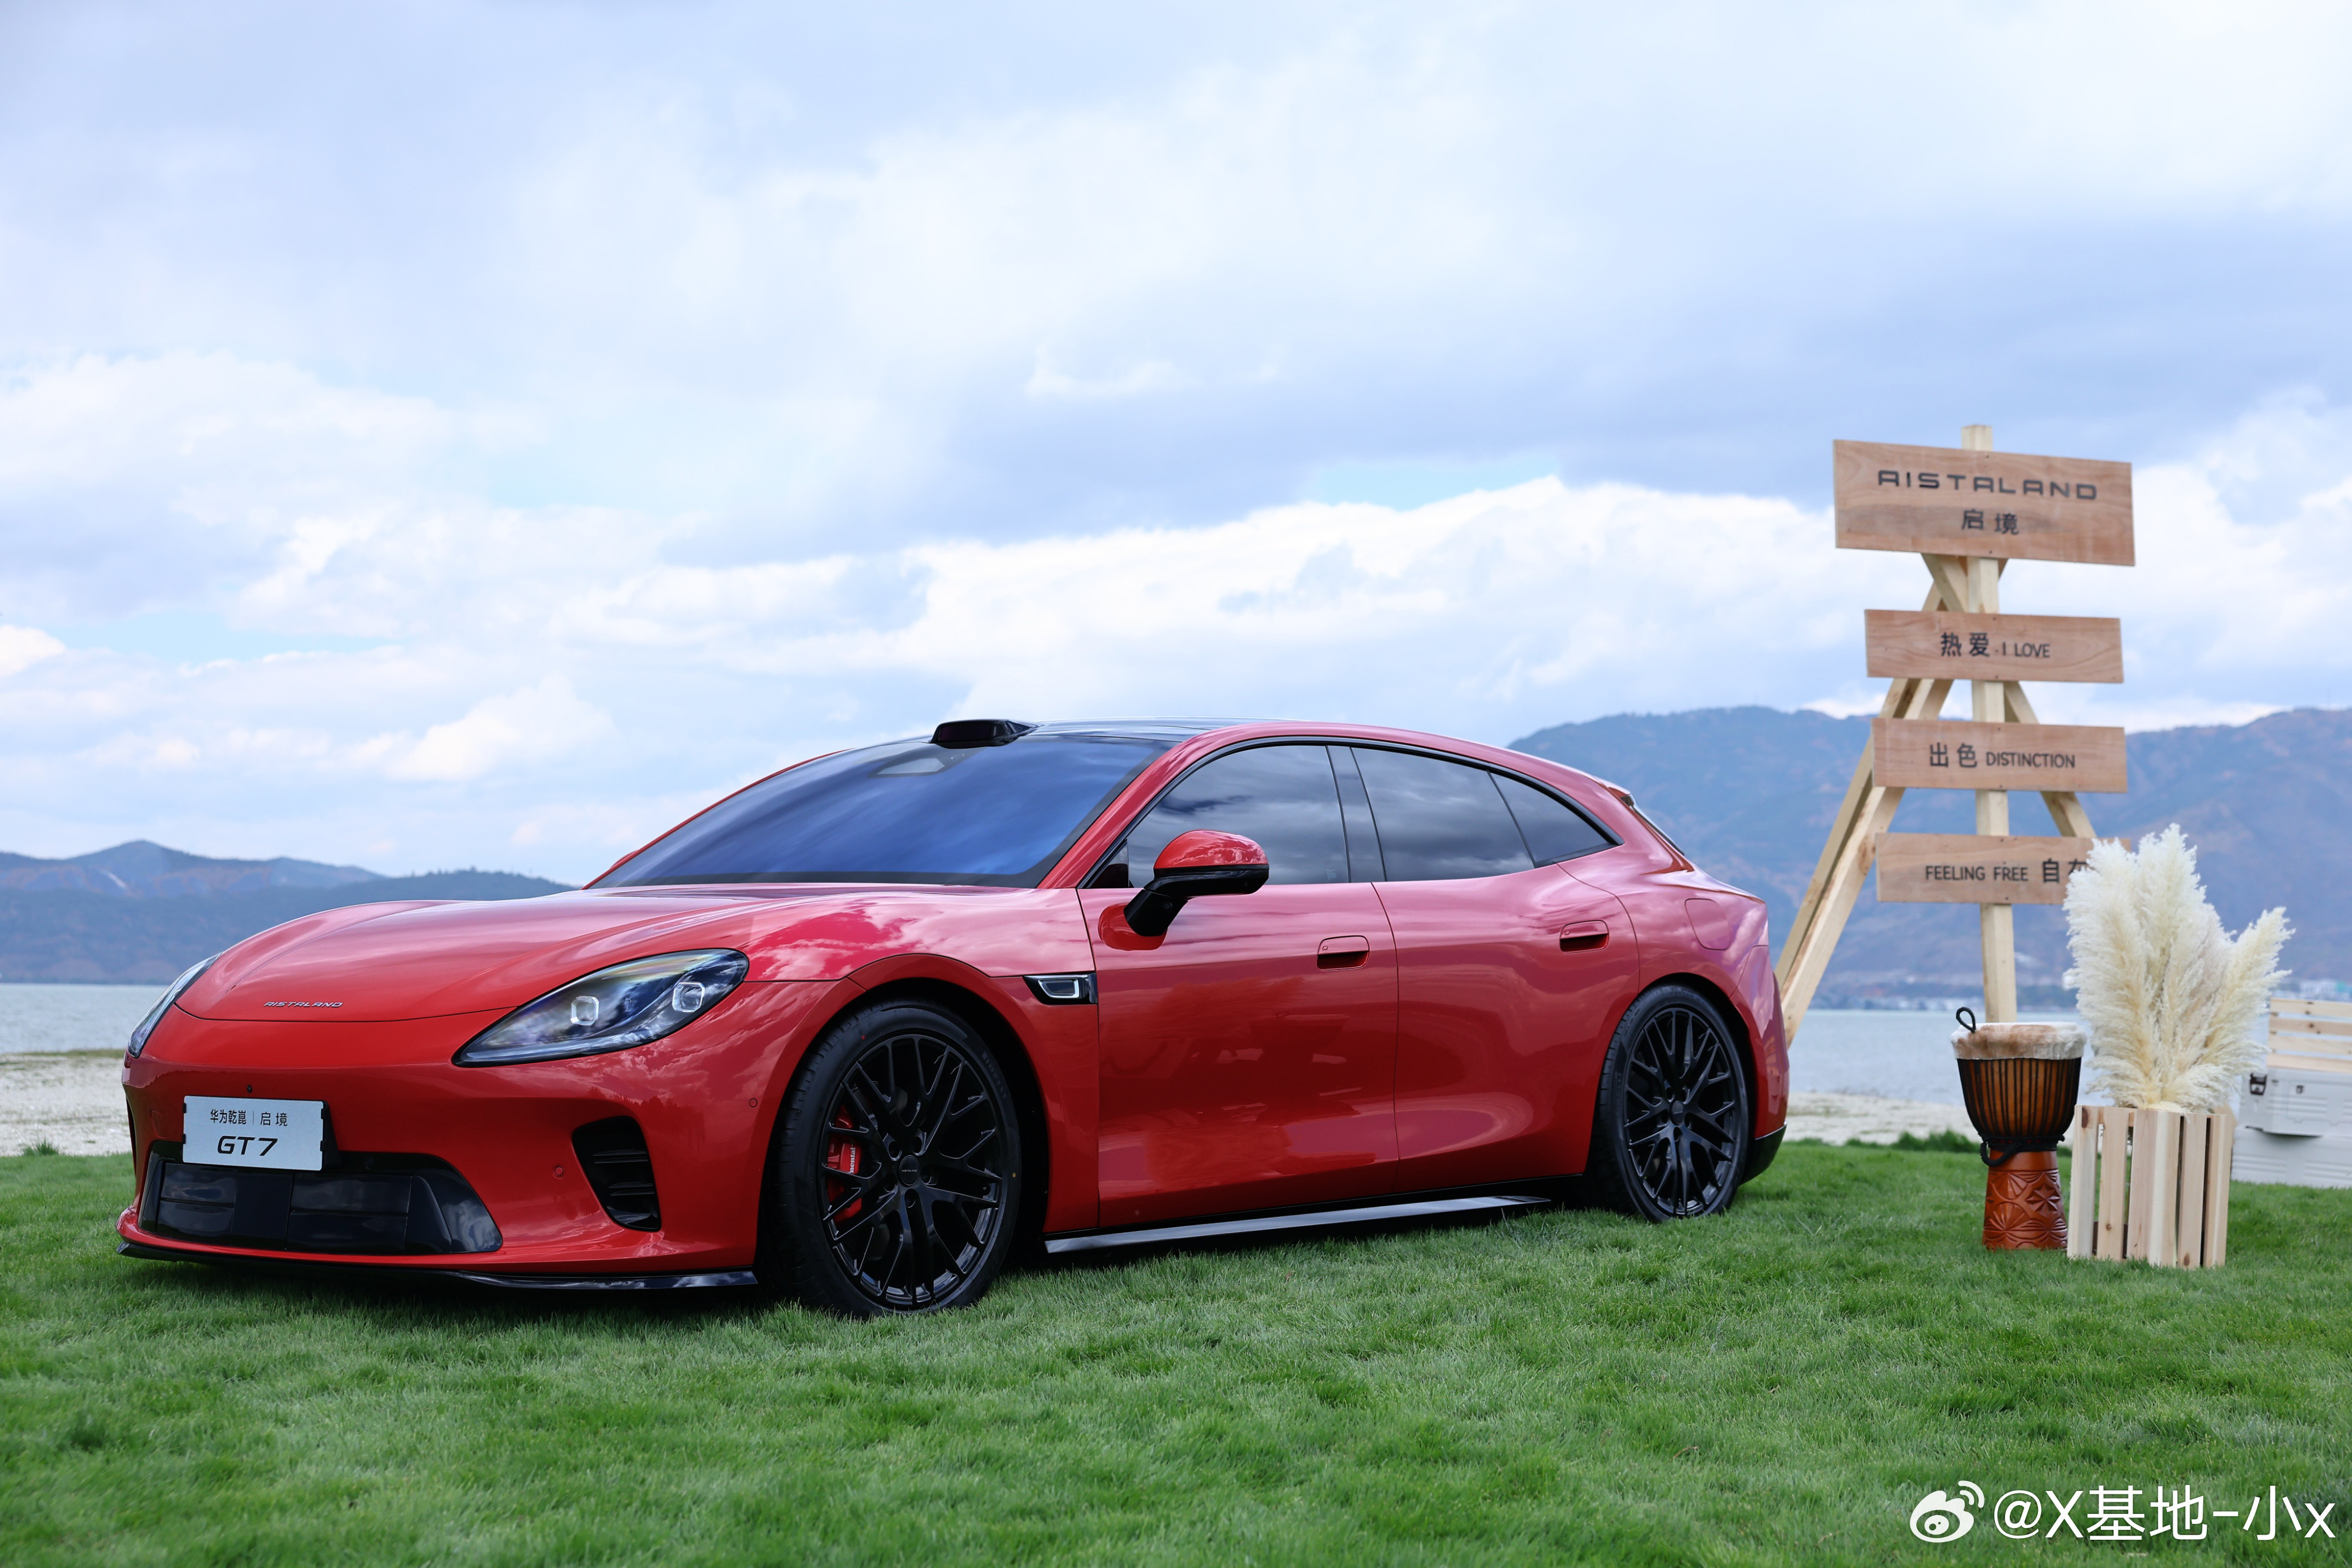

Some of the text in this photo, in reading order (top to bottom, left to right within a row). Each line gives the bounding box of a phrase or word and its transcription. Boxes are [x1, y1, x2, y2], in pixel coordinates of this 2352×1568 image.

[1877, 470, 2097, 500] AISTALAND
[1961, 509, 2019, 535] 启境
[1940, 632, 2050, 658] 热爱 I LOVE
[1929, 742, 2076, 768] 出色 DISTINCTION
[1925, 865, 1986, 881] FEELING
[1993, 867, 2029, 881] FREE
[209, 1109, 288, 1126] 华为乾崑 启境
[217, 1135, 278, 1156] GT7
